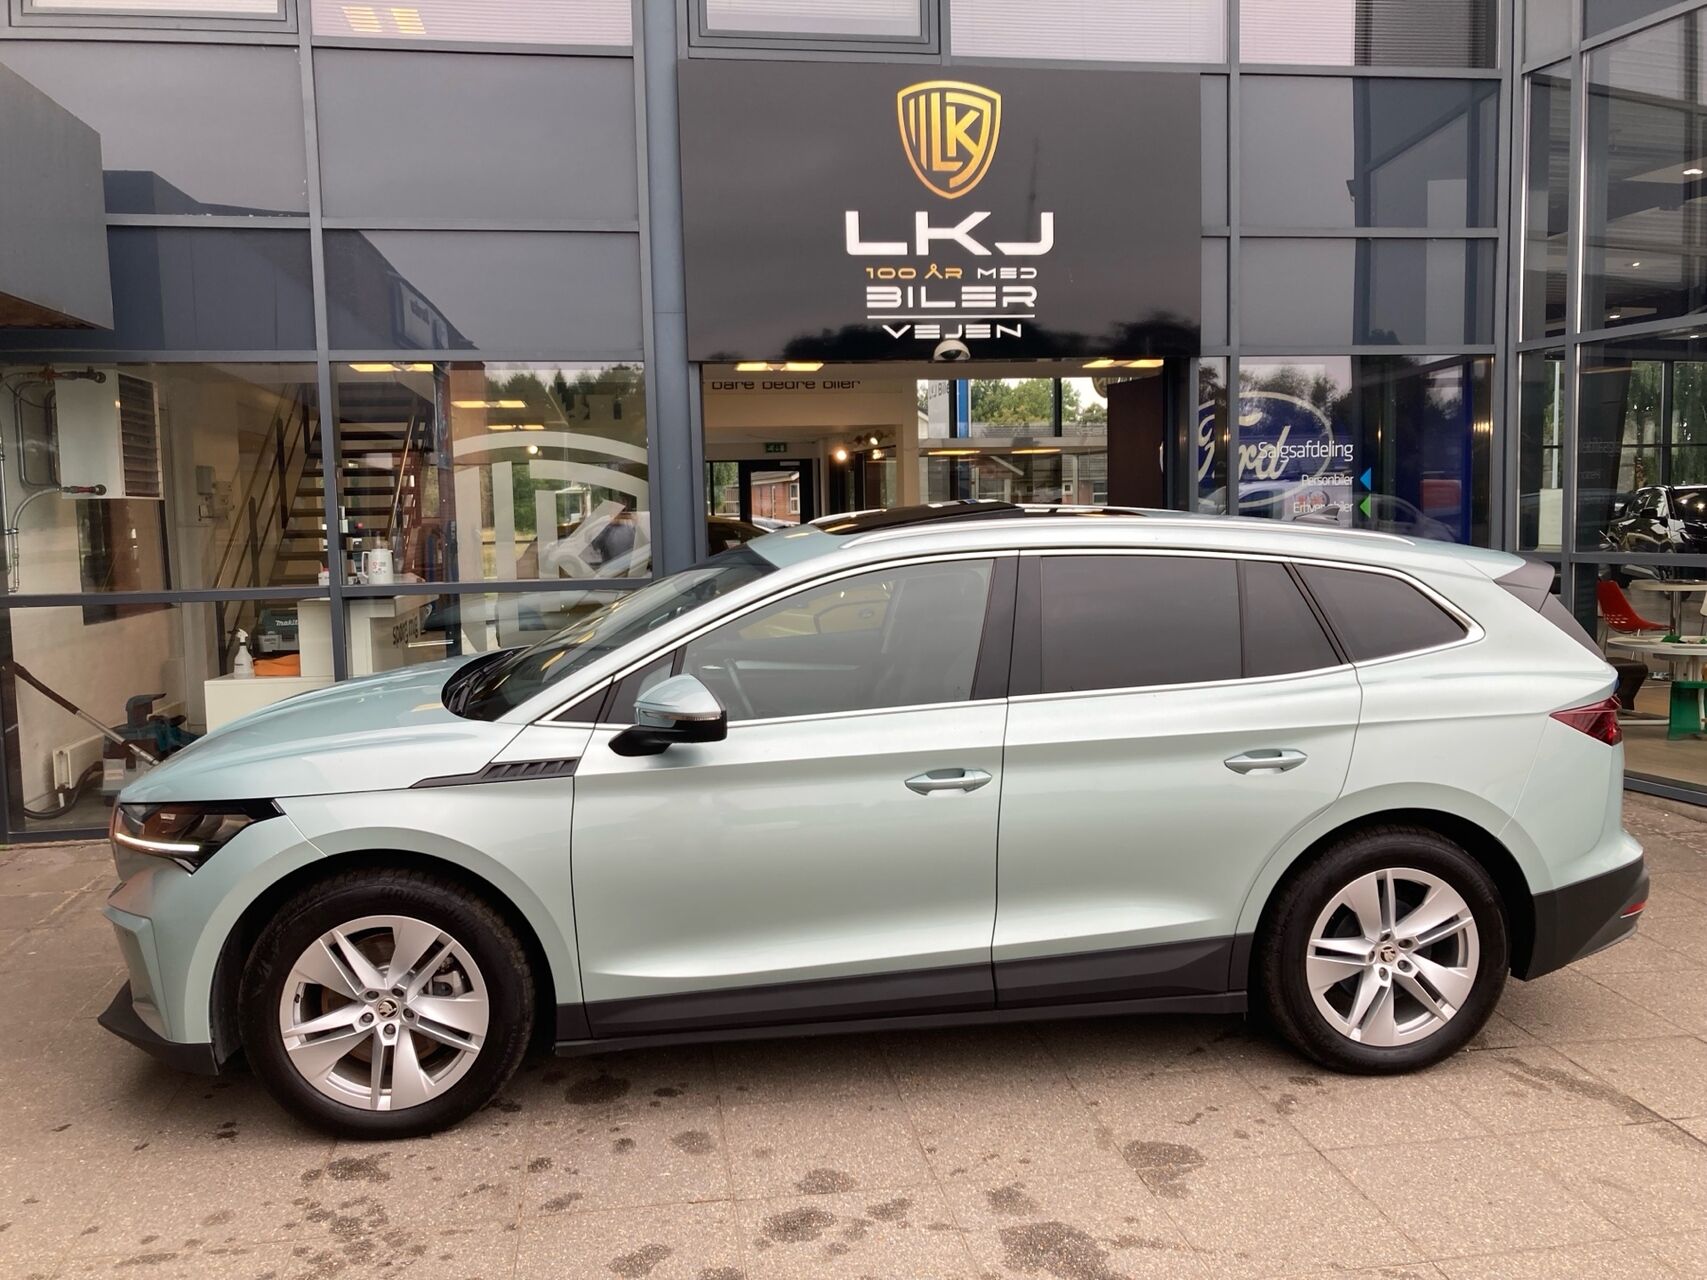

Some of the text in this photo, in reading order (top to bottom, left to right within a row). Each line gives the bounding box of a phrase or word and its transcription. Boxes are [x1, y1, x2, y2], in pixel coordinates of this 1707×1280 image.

[845, 210, 1055, 256] LKJ
[866, 263, 1038, 279] 100 ÅR MED
[866, 286, 1038, 308] BILER
[882, 323, 1022, 339] VEJEN
[1257, 440, 1354, 462] Salgsafdeling
[1301, 474, 1354, 486] Personbiler
[1293, 501, 1354, 513] Erhverbiler
